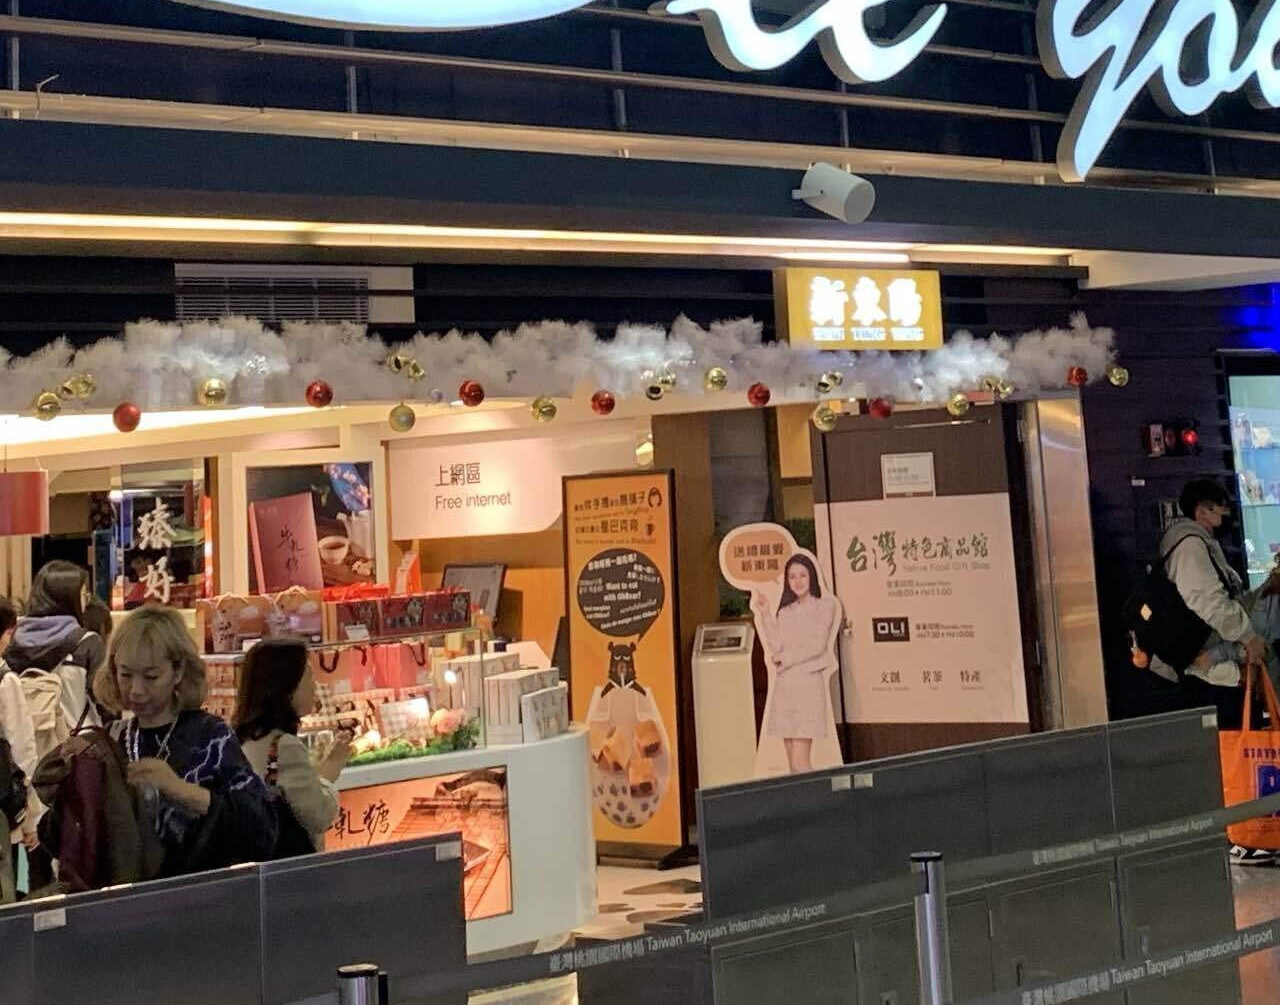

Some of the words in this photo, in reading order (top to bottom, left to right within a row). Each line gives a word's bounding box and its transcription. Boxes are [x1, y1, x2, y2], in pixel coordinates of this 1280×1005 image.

[435, 462, 481, 487] 上網區
[435, 495, 463, 510] Free
[466, 492, 512, 508] internet
[846, 530, 897, 577] 台灣
[901, 532, 989, 562] 特色商品館
[324, 798, 390, 846] 軋糖
[646, 935, 683, 953] Taiwan
[683, 926, 727, 950] Taoyuan
[728, 910, 792, 936] International
[791, 902, 827, 922] Airport
[1110, 966, 1145, 985] Taiwan
[1144, 954, 1185, 978] Taoyuan
[1185, 936, 1242, 966] International
[1241, 928, 1274, 949] Airport
